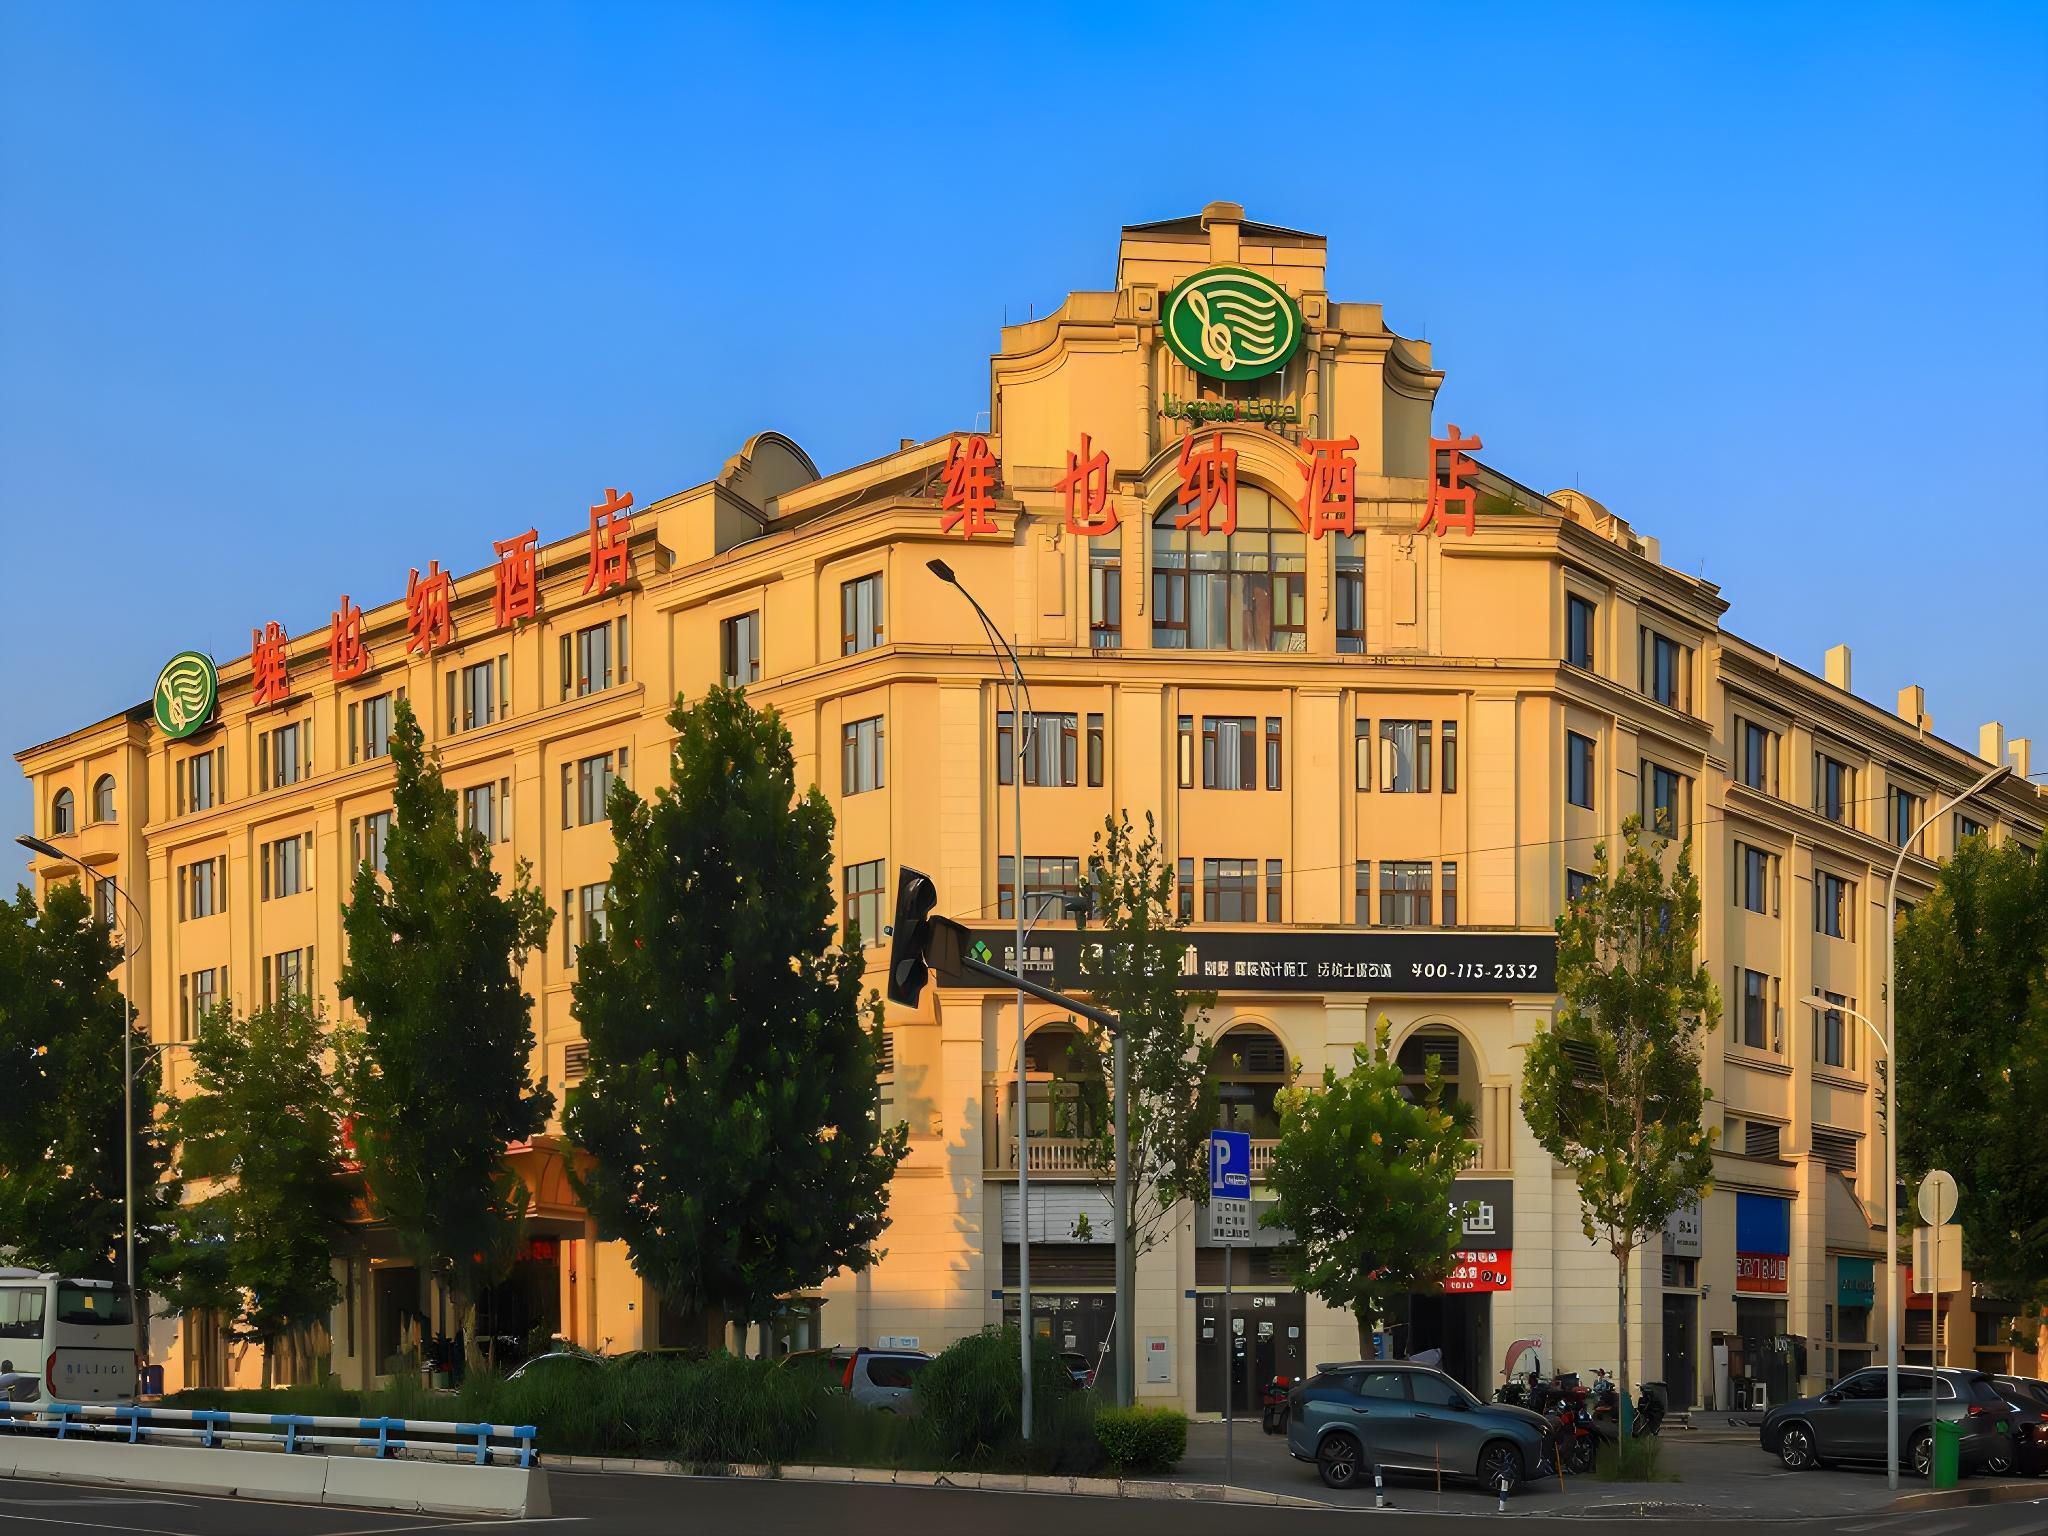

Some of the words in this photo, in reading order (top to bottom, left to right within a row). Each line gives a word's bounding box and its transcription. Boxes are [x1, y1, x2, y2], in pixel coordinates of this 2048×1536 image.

[940, 424, 1483, 539] 维也纳酒店
[252, 487, 634, 707] 维也纳酒店
[1213, 1139, 1231, 1189] P
